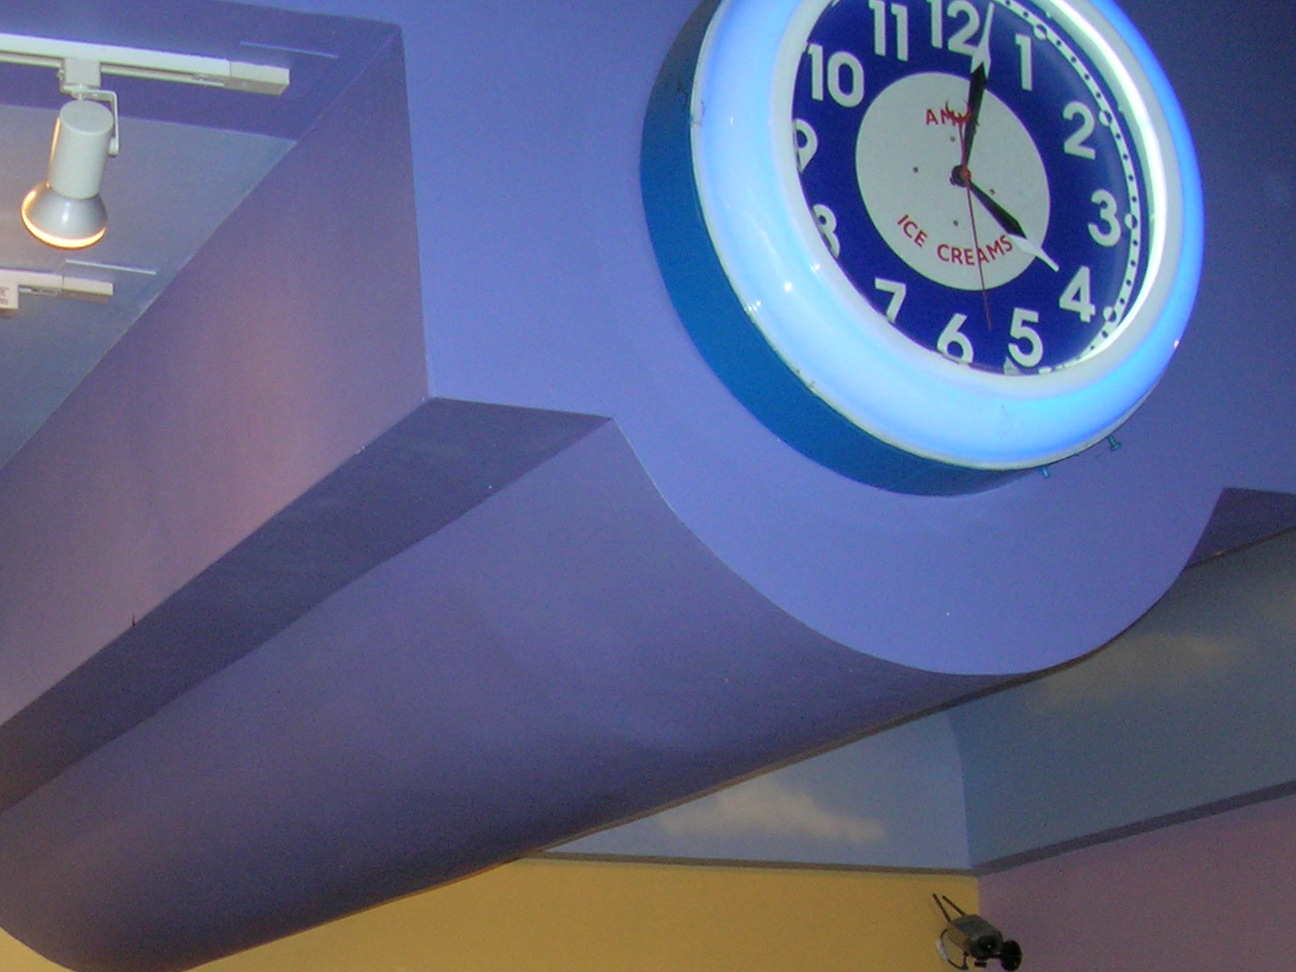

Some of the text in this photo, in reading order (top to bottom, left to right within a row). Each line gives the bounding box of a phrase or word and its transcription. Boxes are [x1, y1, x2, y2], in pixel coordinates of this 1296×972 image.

[869, 0, 909, 62] 11
[926, 0, 982, 57] 12
[805, 43, 866, 107] 10
[1015, 33, 1034, 91] 1
[1062, 101, 1097, 160] 2
[897, 214, 1014, 266] ICE CREAMS
[1088, 189, 1122, 247] 3
[874, 277, 907, 324] 7
[1058, 266, 1096, 323] 4
[936, 312, 974, 365] 6
[1007, 307, 1044, 368] 5
